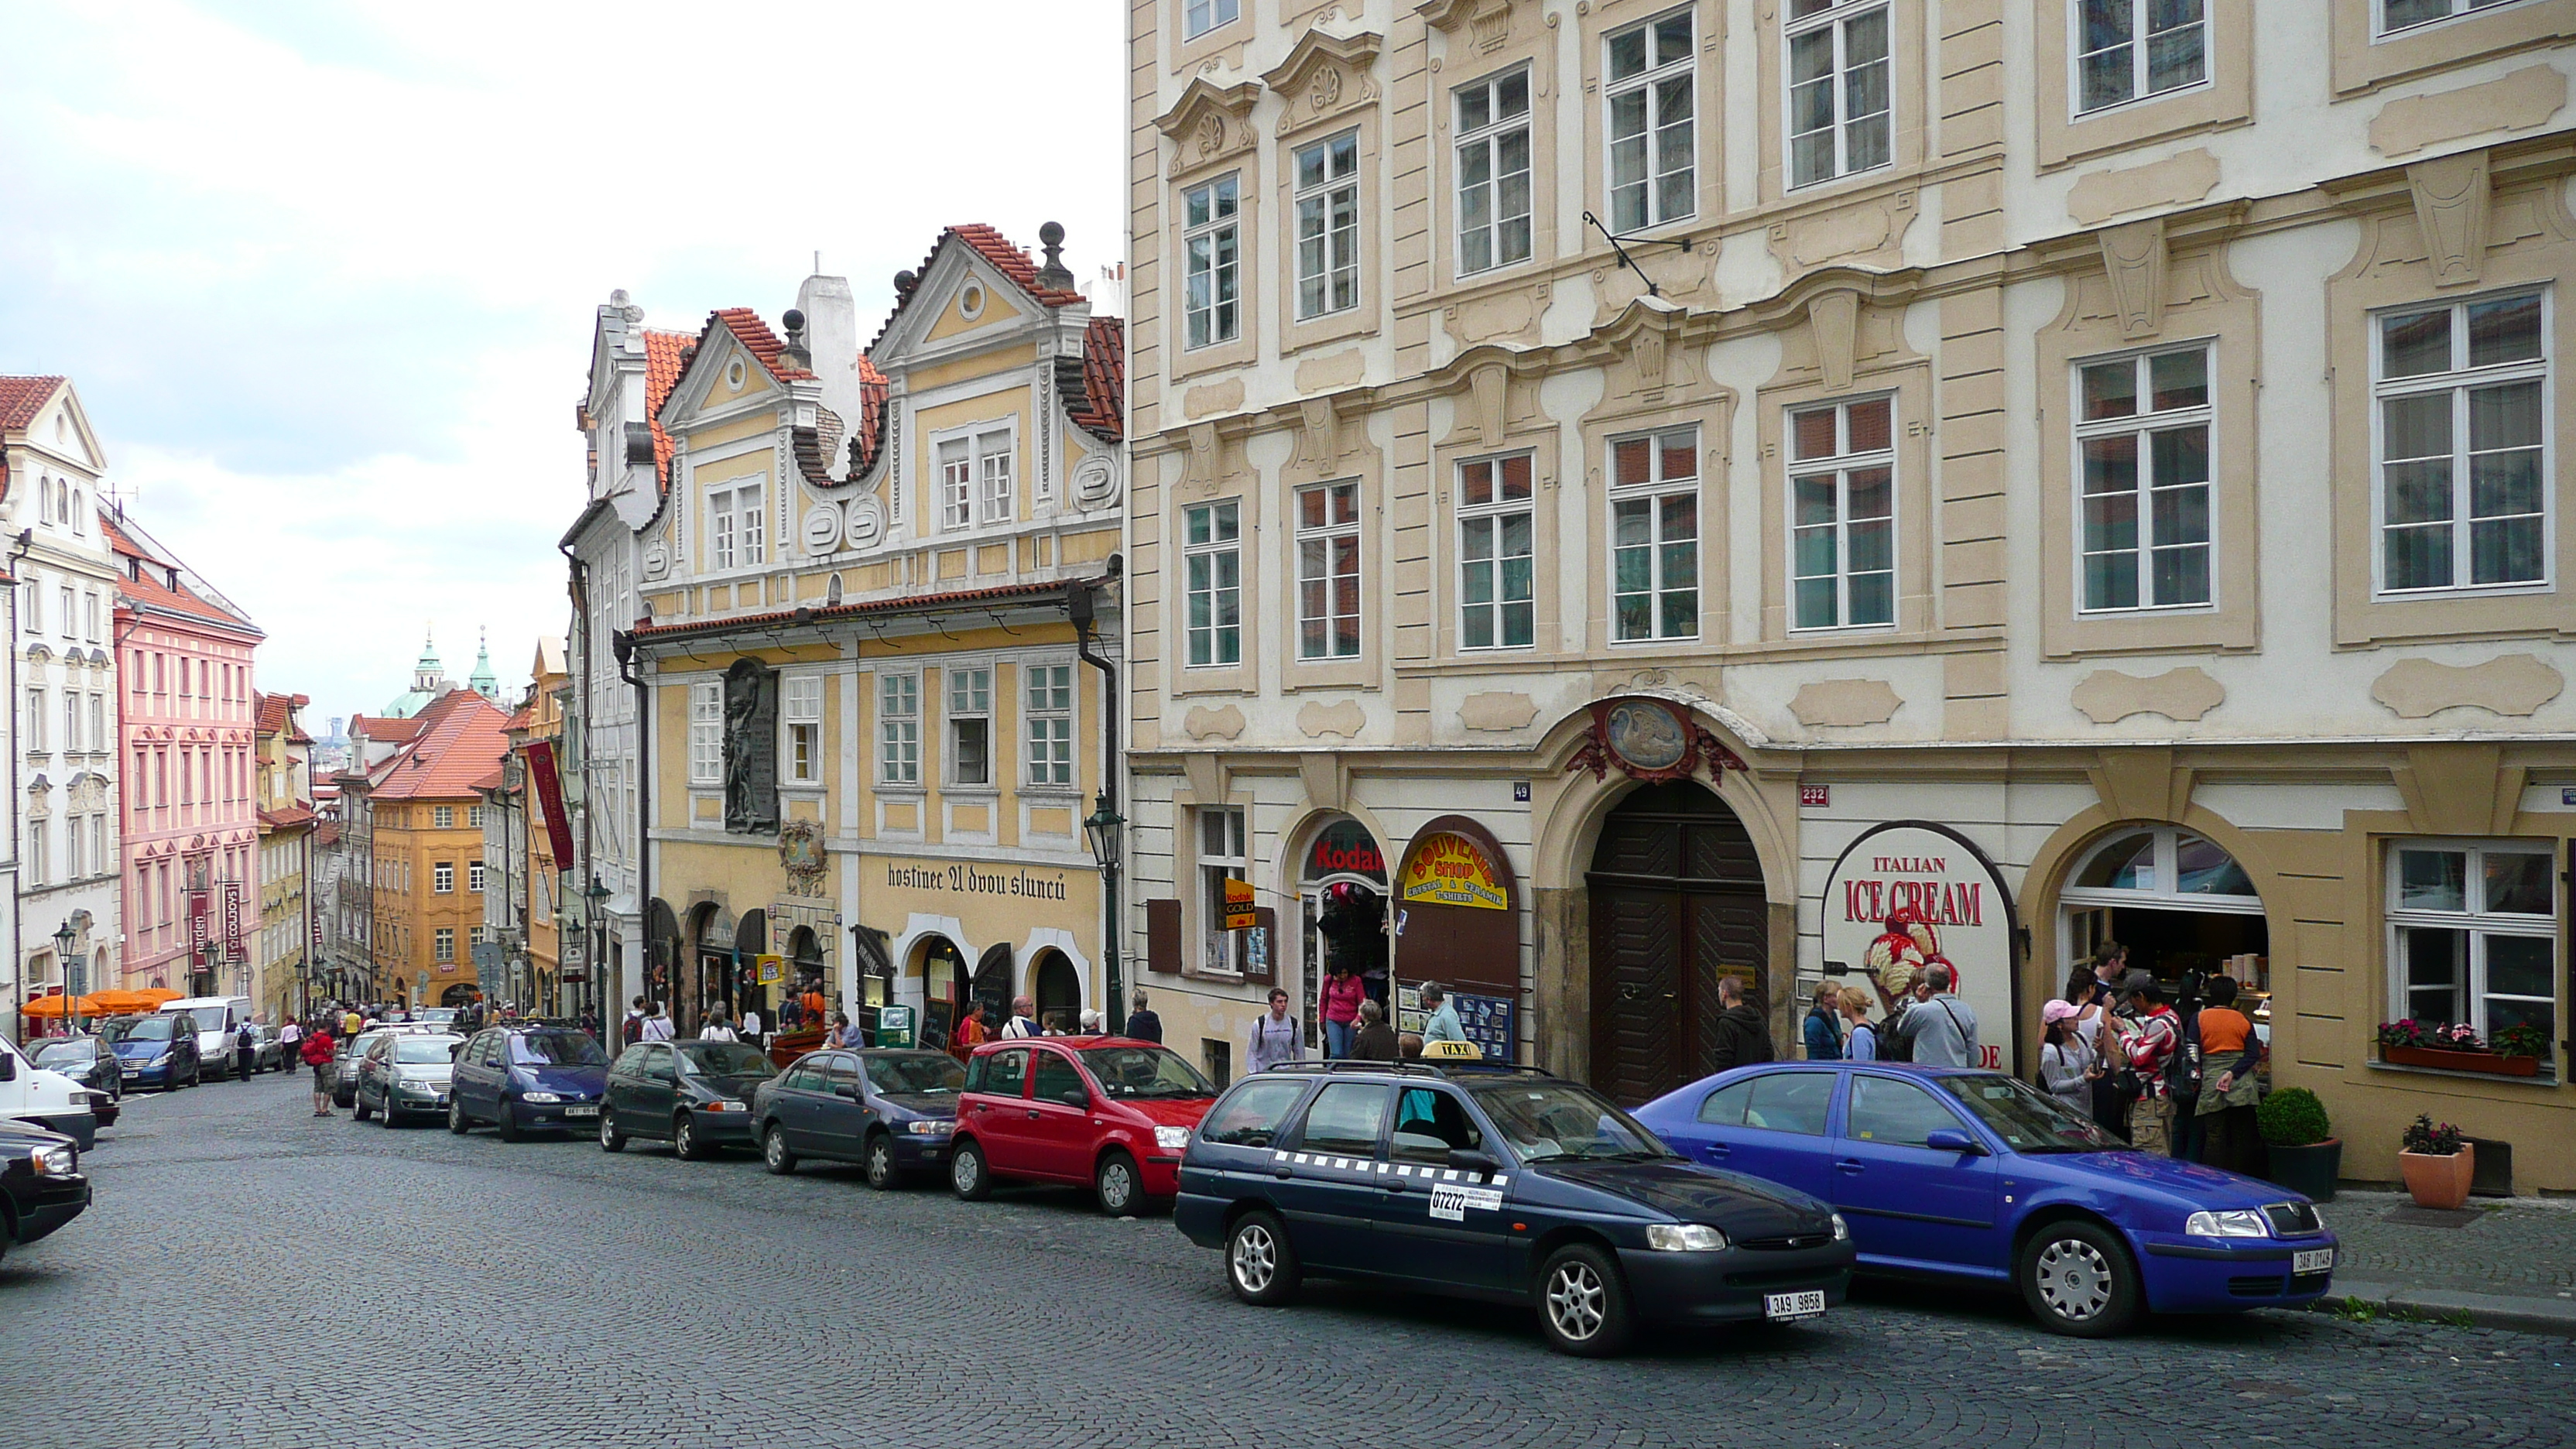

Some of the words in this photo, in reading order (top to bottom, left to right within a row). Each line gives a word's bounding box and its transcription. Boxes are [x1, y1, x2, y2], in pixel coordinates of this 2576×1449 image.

[1516, 786, 1527, 798] 49
[1803, 788, 1825, 800] 232
[1412, 835, 1495, 887] SOUVENIR
[1434, 860, 1475, 879] SHOP
[1872, 857, 1946, 873] ITALIAN
[887, 862, 944, 890] hostinec
[968, 864, 1005, 896] dvou
[1010, 867, 1066, 901] slunců
[1227, 892, 1252, 903] Kodak
[1406, 879, 1443, 897] CRYSTAL
[1450, 879, 1457, 889] &
[1464, 880, 1504, 906] CERAMIK
[1436, 890, 1474, 903] T-SHIRTS
[1227, 903, 1254, 913] GOLD
[1844, 879, 1885, 923] ICE
[1889, 880, 1982, 927] CREAM
[228, 890, 238, 937] COWBOYS
[1442, 1044, 1471, 1055] TAXI
[1433, 1190, 1464, 1211] 07272
[1773, 1295, 1792, 1314] 3A9
[1798, 1293, 1821, 1311] 9858
